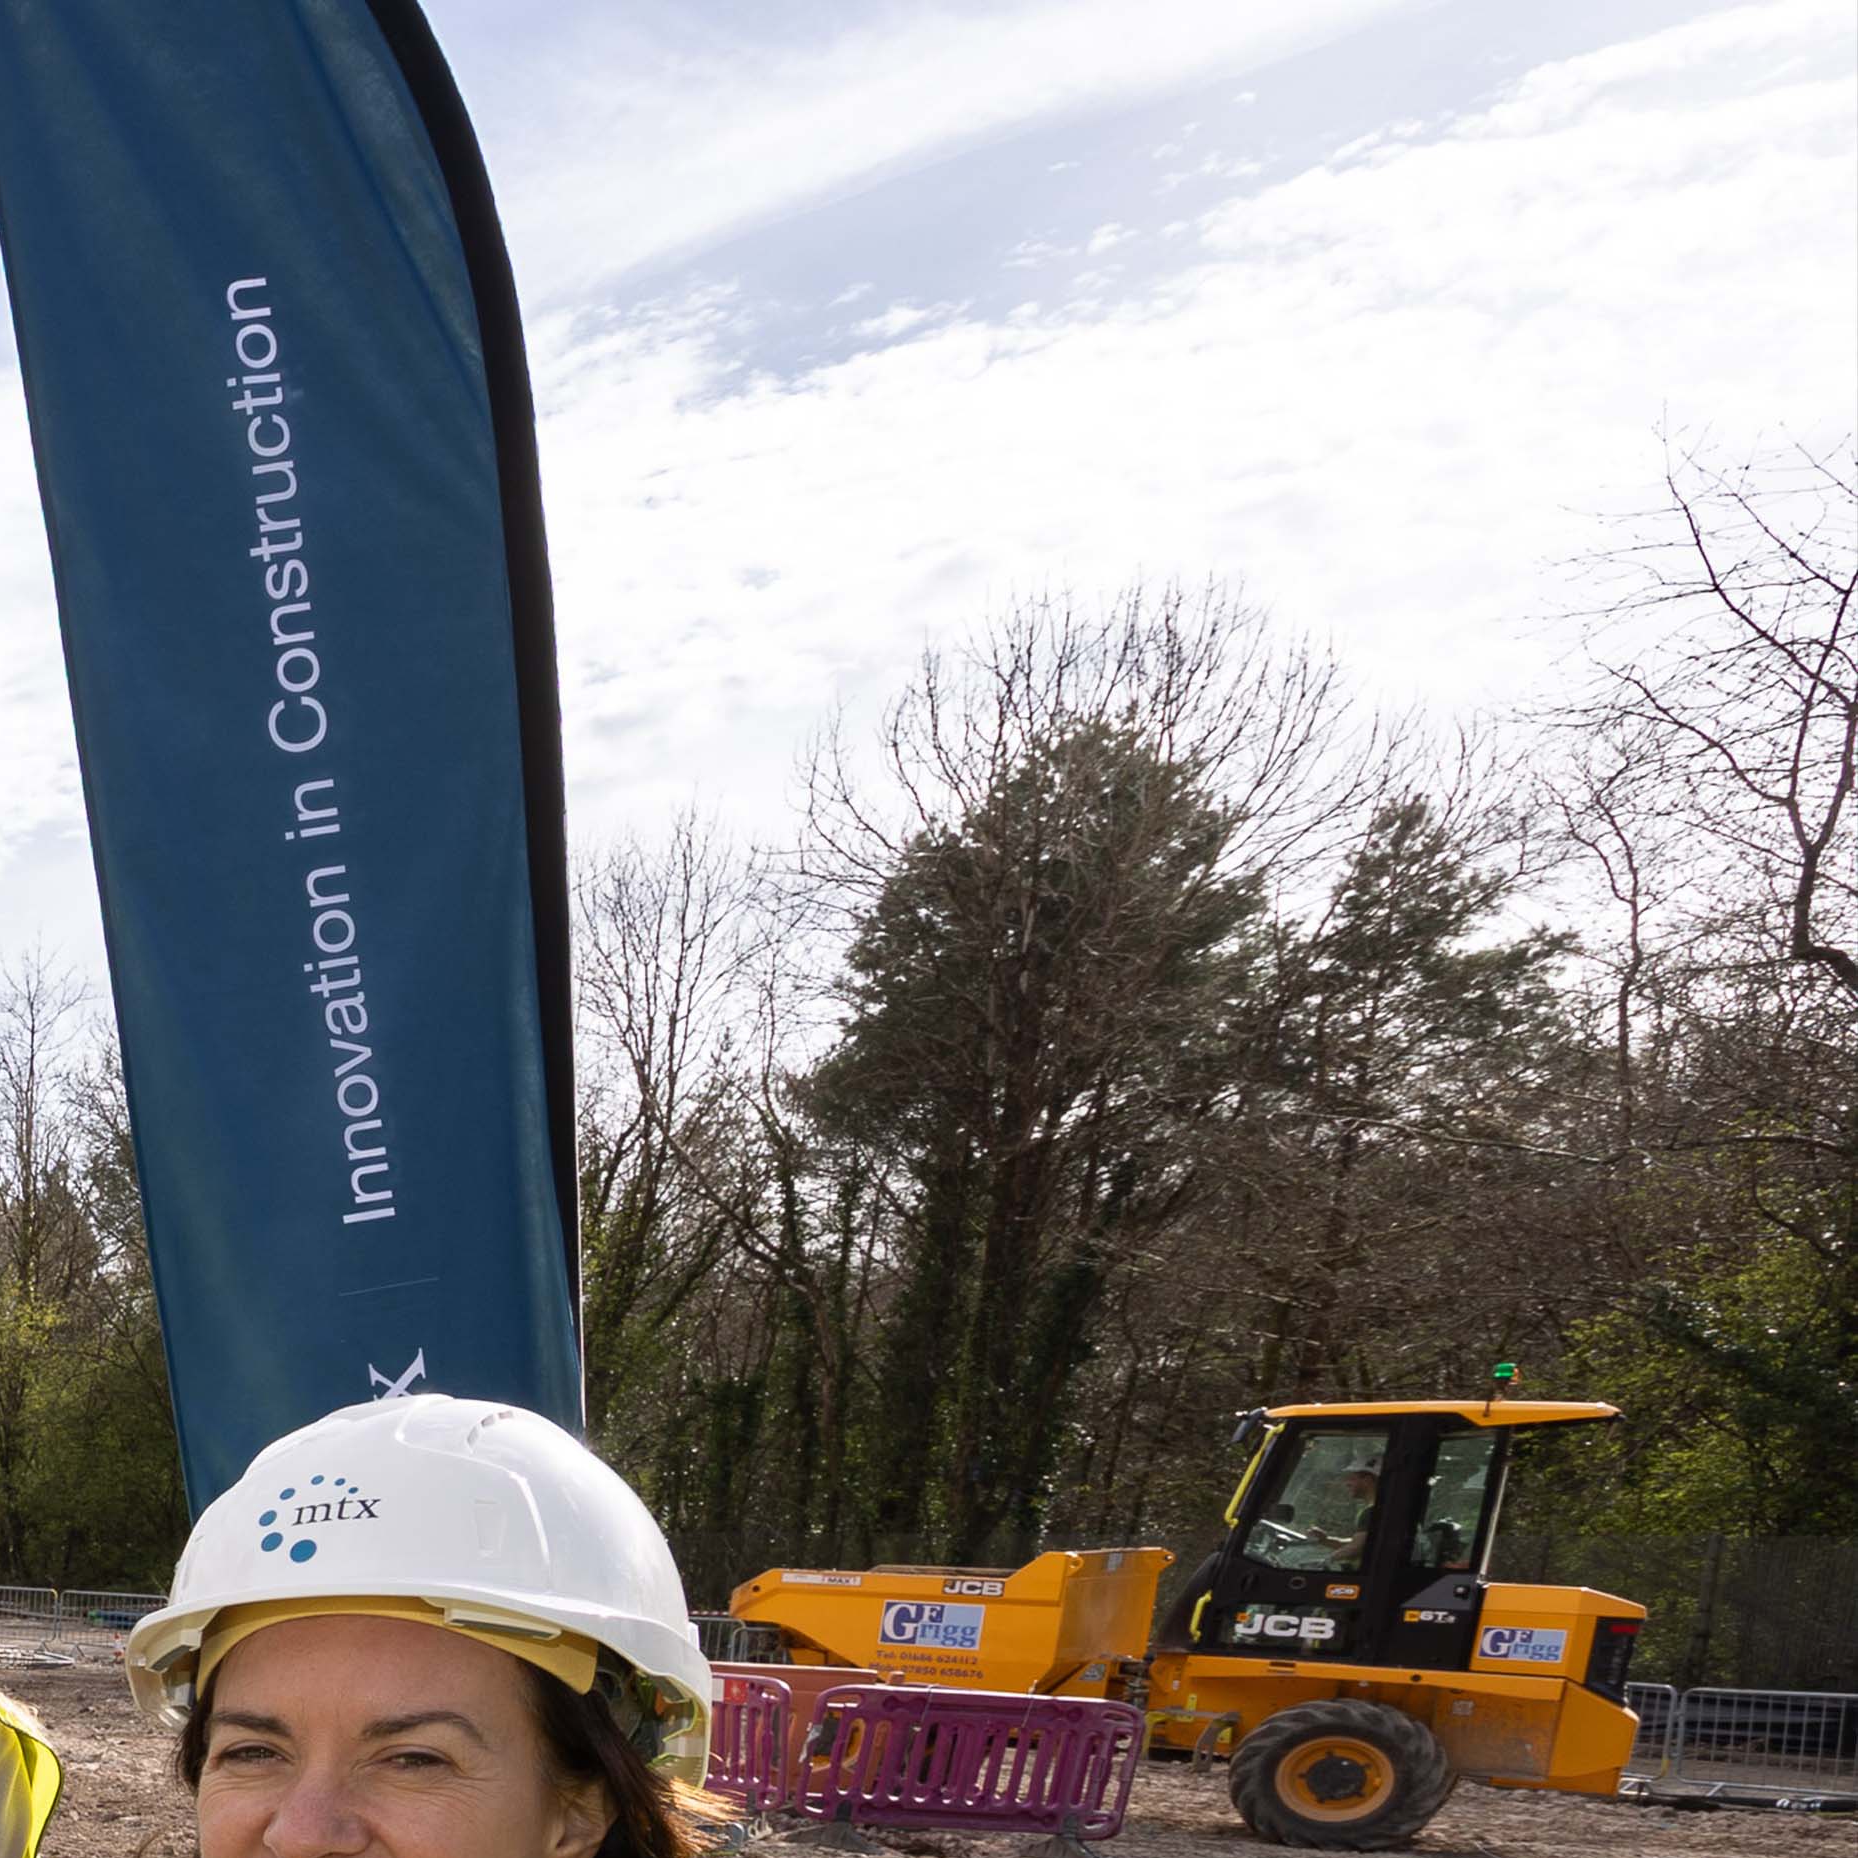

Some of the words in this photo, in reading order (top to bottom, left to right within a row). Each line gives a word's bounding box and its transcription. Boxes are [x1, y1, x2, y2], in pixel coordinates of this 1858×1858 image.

[227, 275, 328, 755] Construction
[285, 778, 340, 850] in
[288, 859, 397, 1225] Innovation
[292, 1497, 381, 1526] mtx
[944, 1580, 1003, 1596] JCB
[1235, 1612, 1335, 1640] JCB
